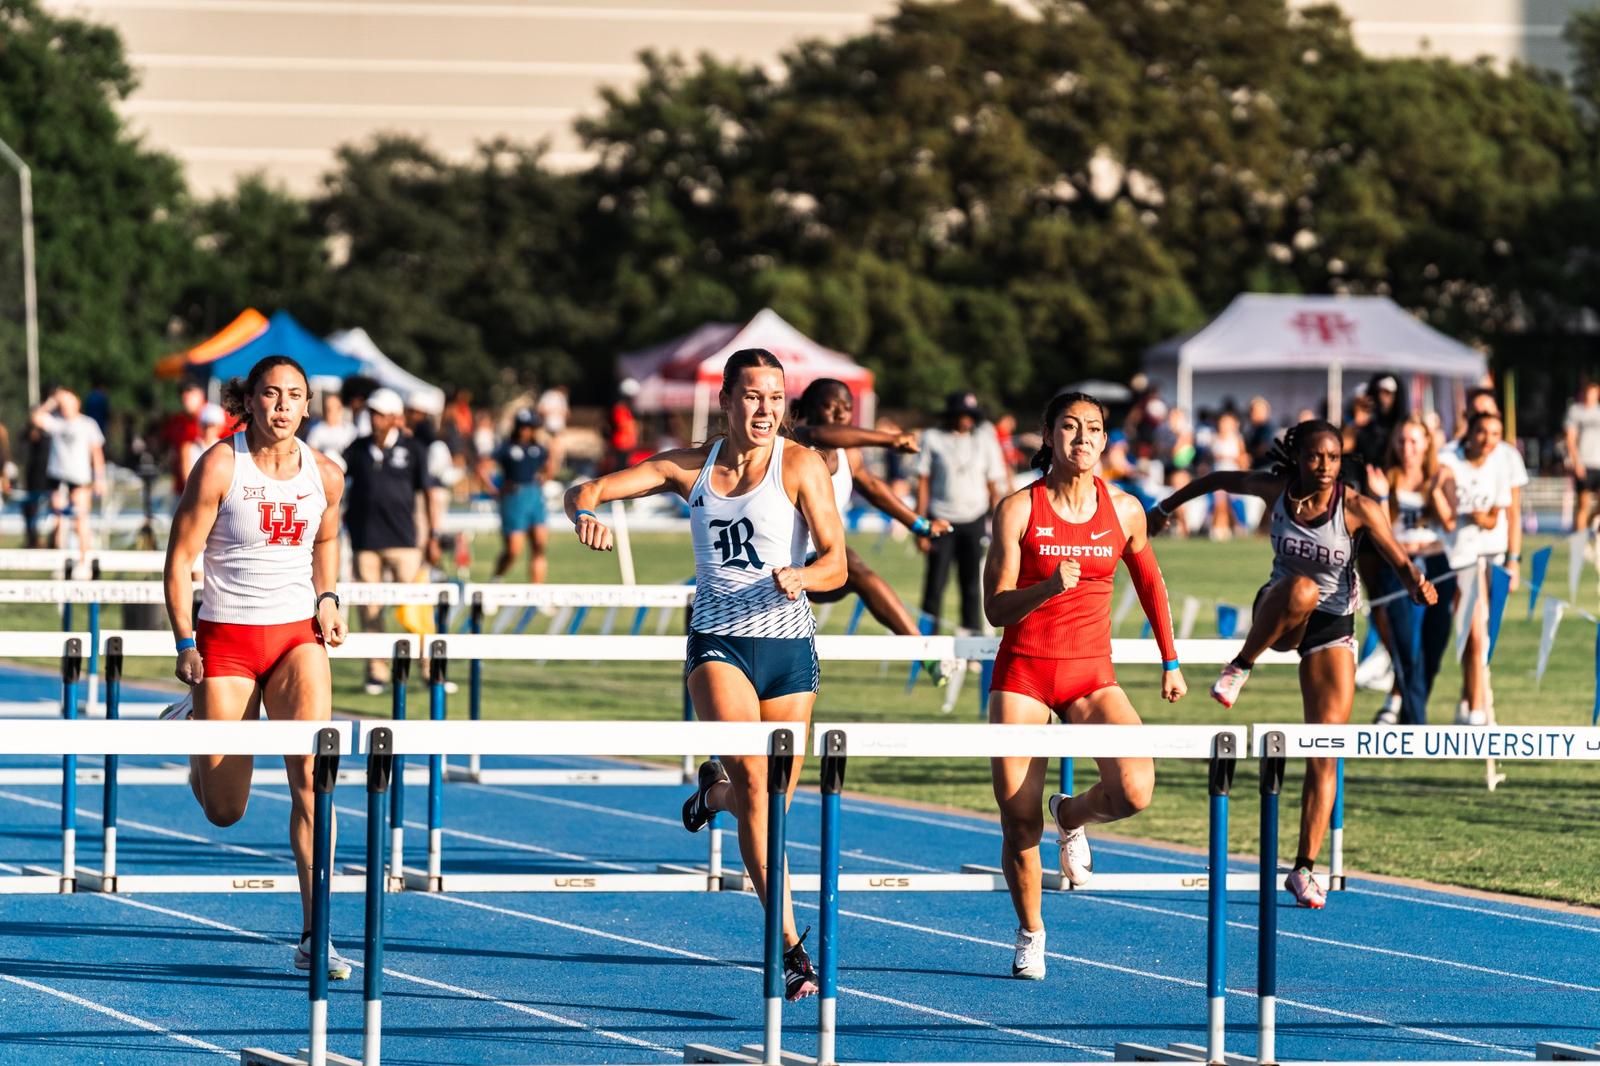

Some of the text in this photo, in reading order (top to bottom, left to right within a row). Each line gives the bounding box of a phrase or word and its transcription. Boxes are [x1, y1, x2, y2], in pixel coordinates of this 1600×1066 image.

[258, 501, 308, 546] UH
[709, 516, 766, 570] R
[1039, 544, 1113, 557] HOUSTON
[1271, 534, 1345, 567] IGERS
[1299, 737, 1345, 748] UCS
[1357, 731, 1414, 755] RICE
[1424, 732, 1576, 756] UNIVERSITY
[232, 879, 274, 889] UCS
[554, 878, 596, 887] UCS
[869, 878, 909, 887] UCS
[1181, 878, 1208, 887] UC
